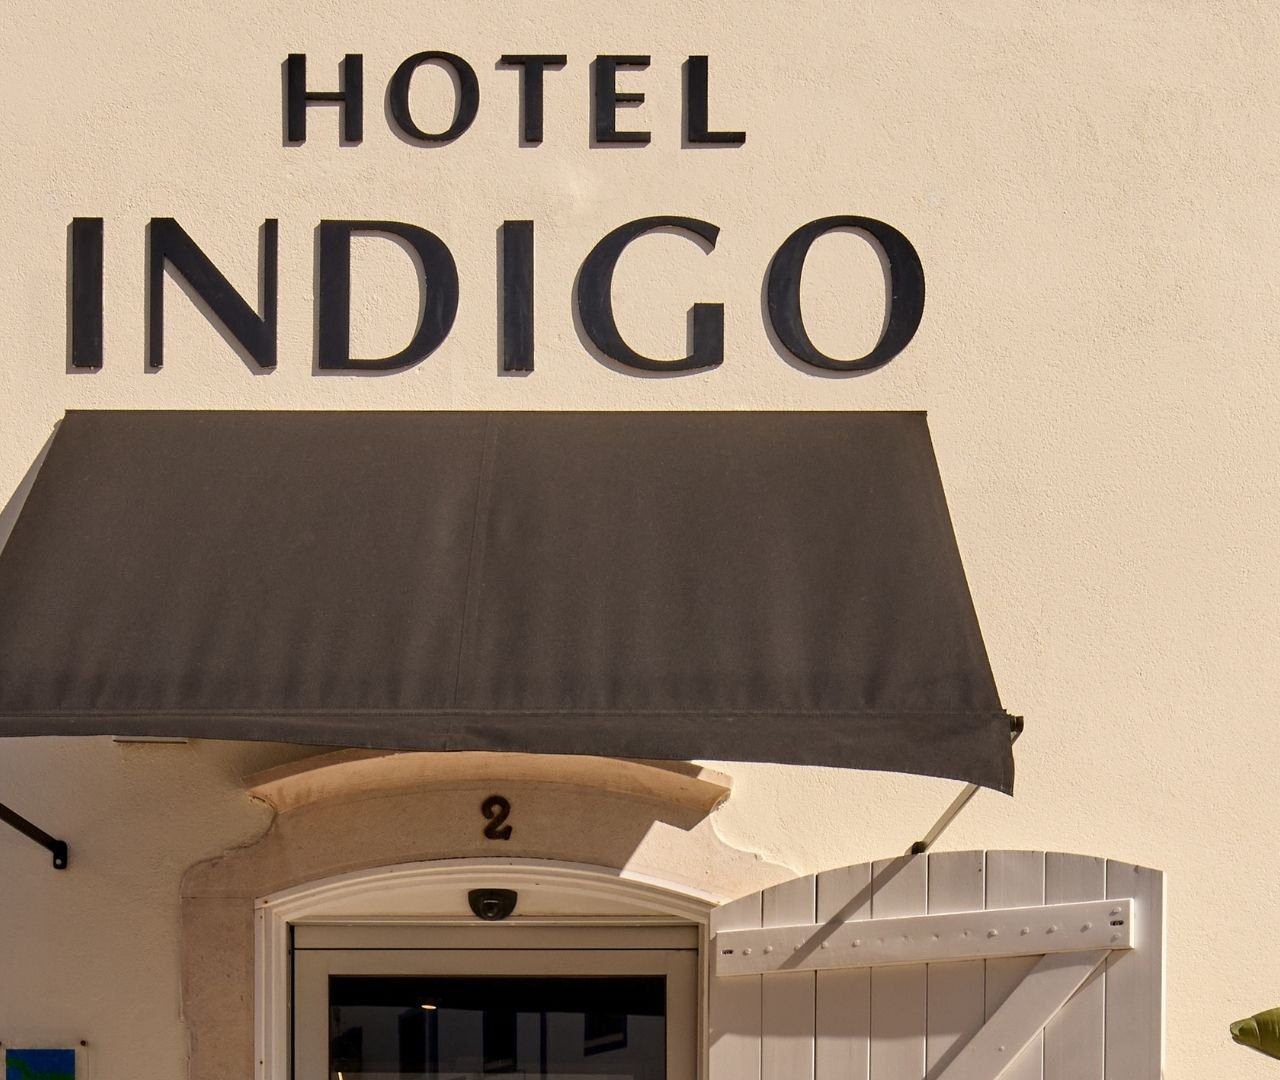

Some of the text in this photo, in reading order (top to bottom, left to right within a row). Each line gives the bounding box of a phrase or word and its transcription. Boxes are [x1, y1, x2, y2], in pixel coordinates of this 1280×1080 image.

[284, 50, 747, 144] HOTEL
[68, 214, 926, 376] INDIGO
[481, 795, 513, 840] 2
